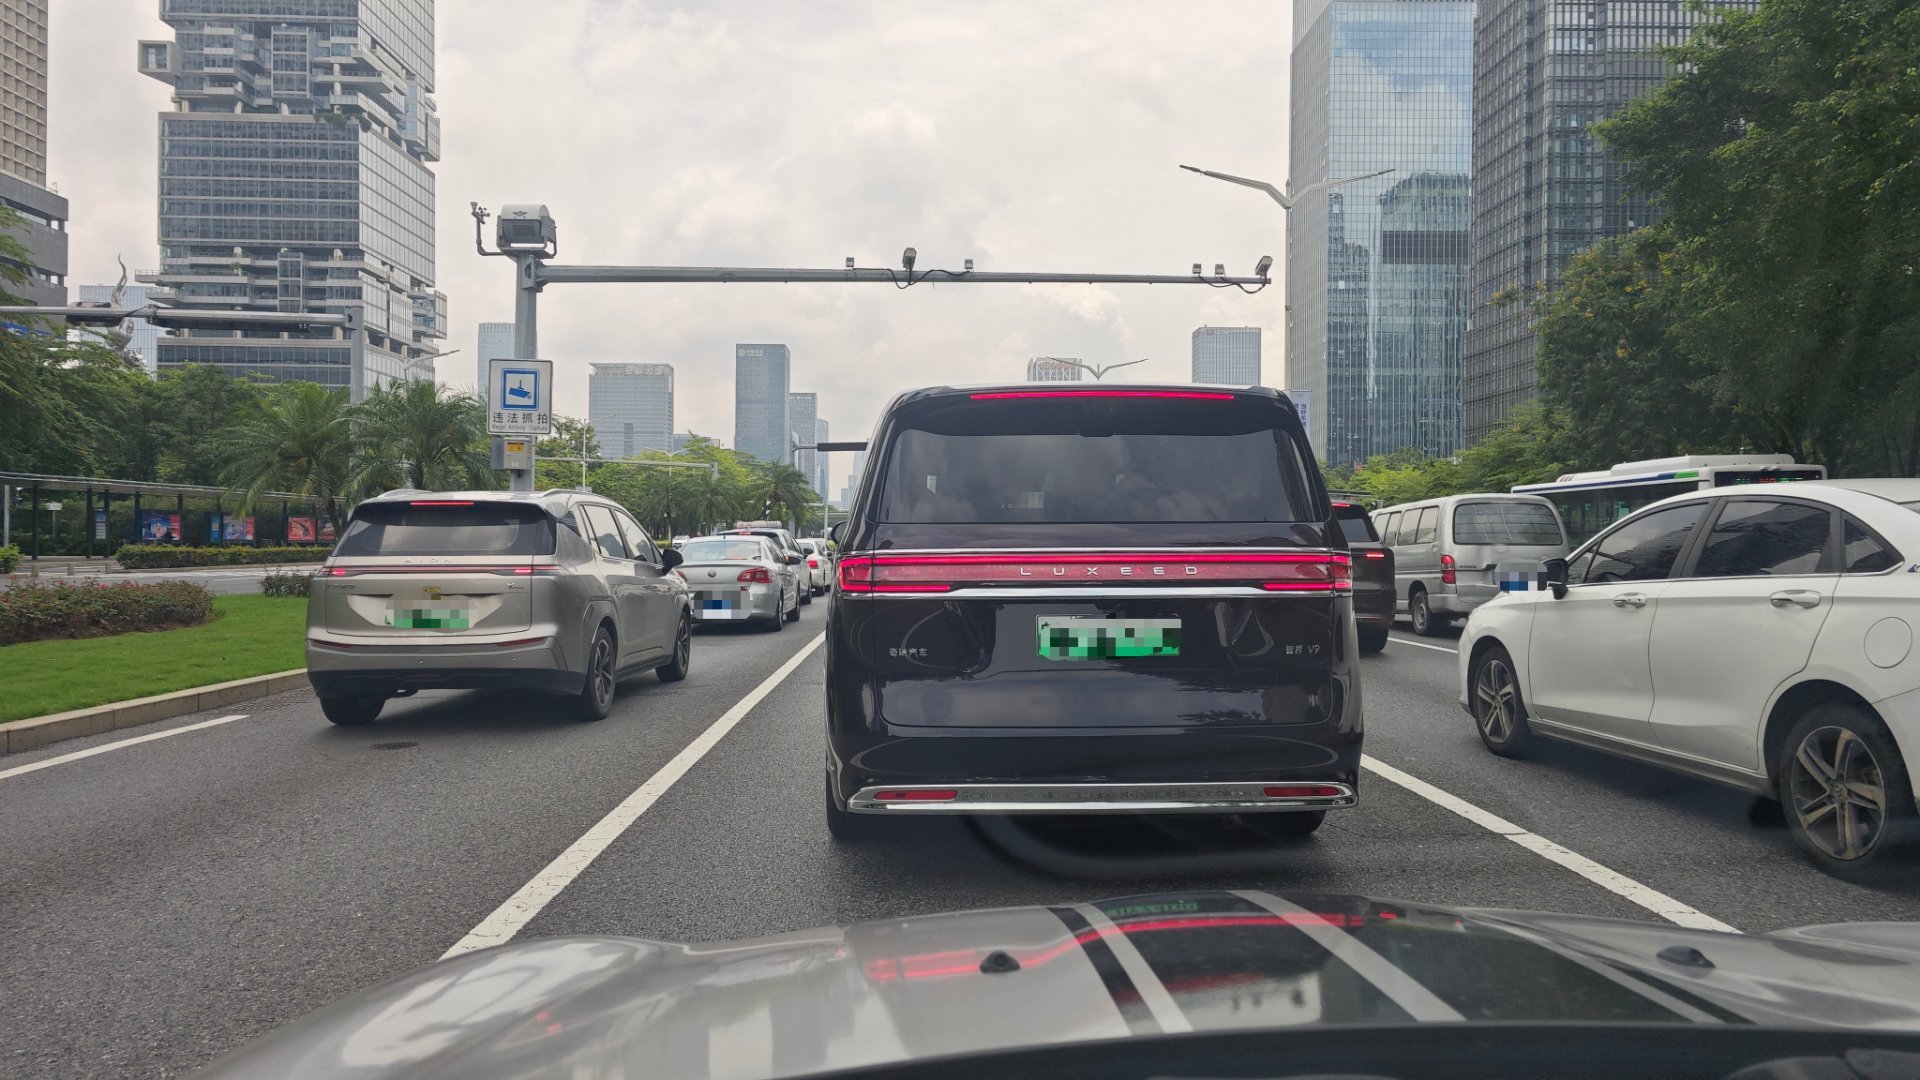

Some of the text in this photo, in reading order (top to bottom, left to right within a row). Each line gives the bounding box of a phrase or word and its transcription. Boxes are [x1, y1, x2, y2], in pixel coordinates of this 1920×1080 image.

[492, 412, 548, 425] 违法抓拍
[1020, 566, 1198, 576] LUXEED
[889, 648, 928, 657] 奇瑞汽车
[1285, 644, 1320, 655] 智界 V9
